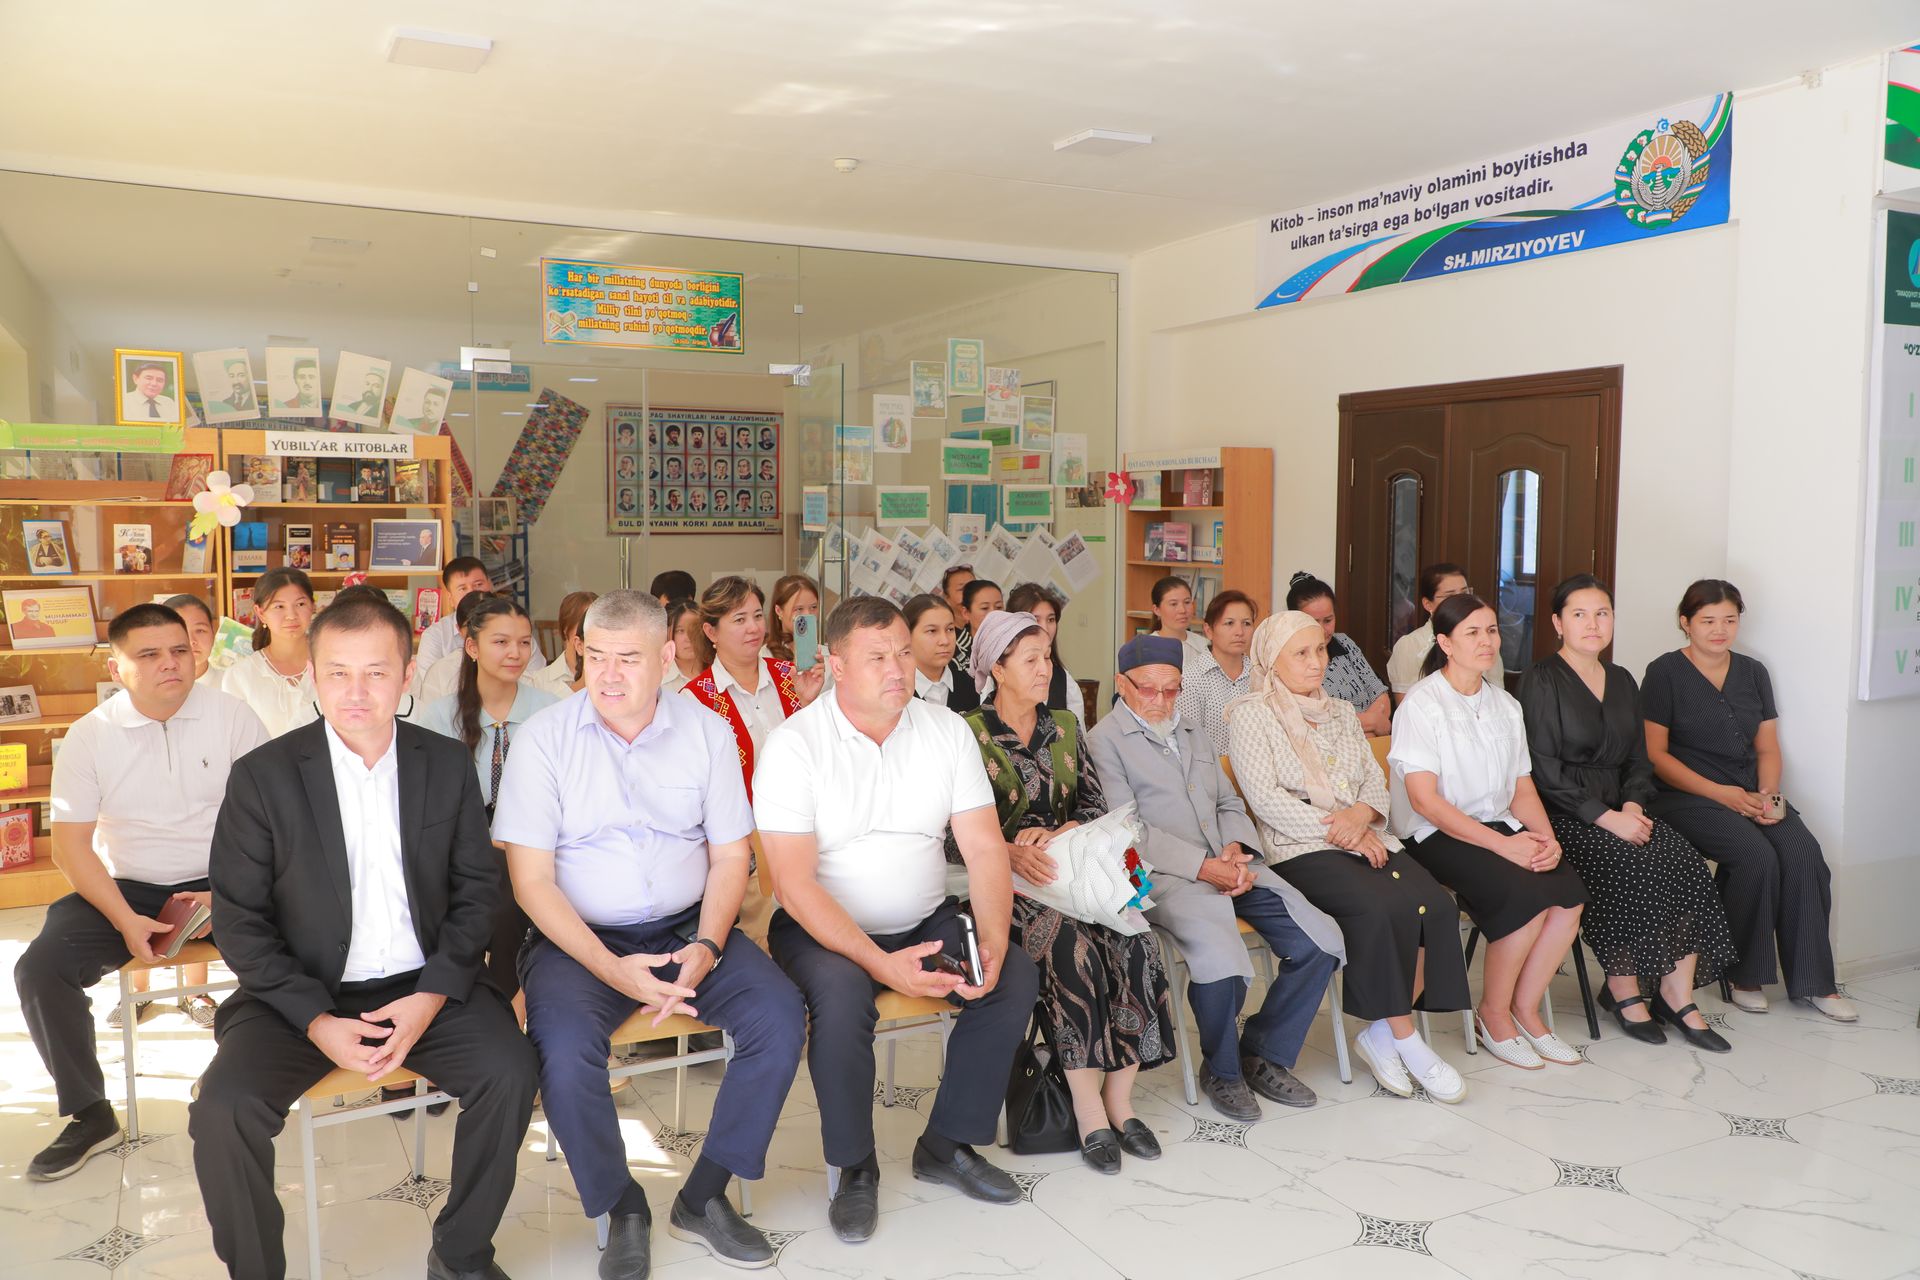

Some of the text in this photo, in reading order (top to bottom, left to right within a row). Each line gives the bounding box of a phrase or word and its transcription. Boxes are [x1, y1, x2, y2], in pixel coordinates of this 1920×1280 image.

[1270, 213, 1304, 233] Kitob
[1317, 203, 1354, 222] inson
[1358, 184, 1423, 212] ma’naviy
[1427, 165, 1487, 194] olamini
[1492, 141, 1588, 178] boyitishda
[1290, 177, 1554, 250] ulkan ta’sirga ega bo‘lgan vositadir.
[1442, 230, 1585, 271] SH.MIRZIYOYEV
[567, 271, 583, 283] Har
[587, 272, 600, 284] bir
[604, 274, 646, 290] millatning
[649, 277, 683, 291] dunyoda
[596, 303, 620, 316] Milliy
[624, 305, 642, 317] tilni
[662, 293, 673, 305] til
[676, 296, 686, 305] va
[577, 319, 621, 332] millatning
[624, 319, 650, 332] ruhini
[271, 439, 408, 454] YUBILYAR KITOBLAR
[1896, 586, 1914, 611] IV
[1896, 649, 1908, 674] V
